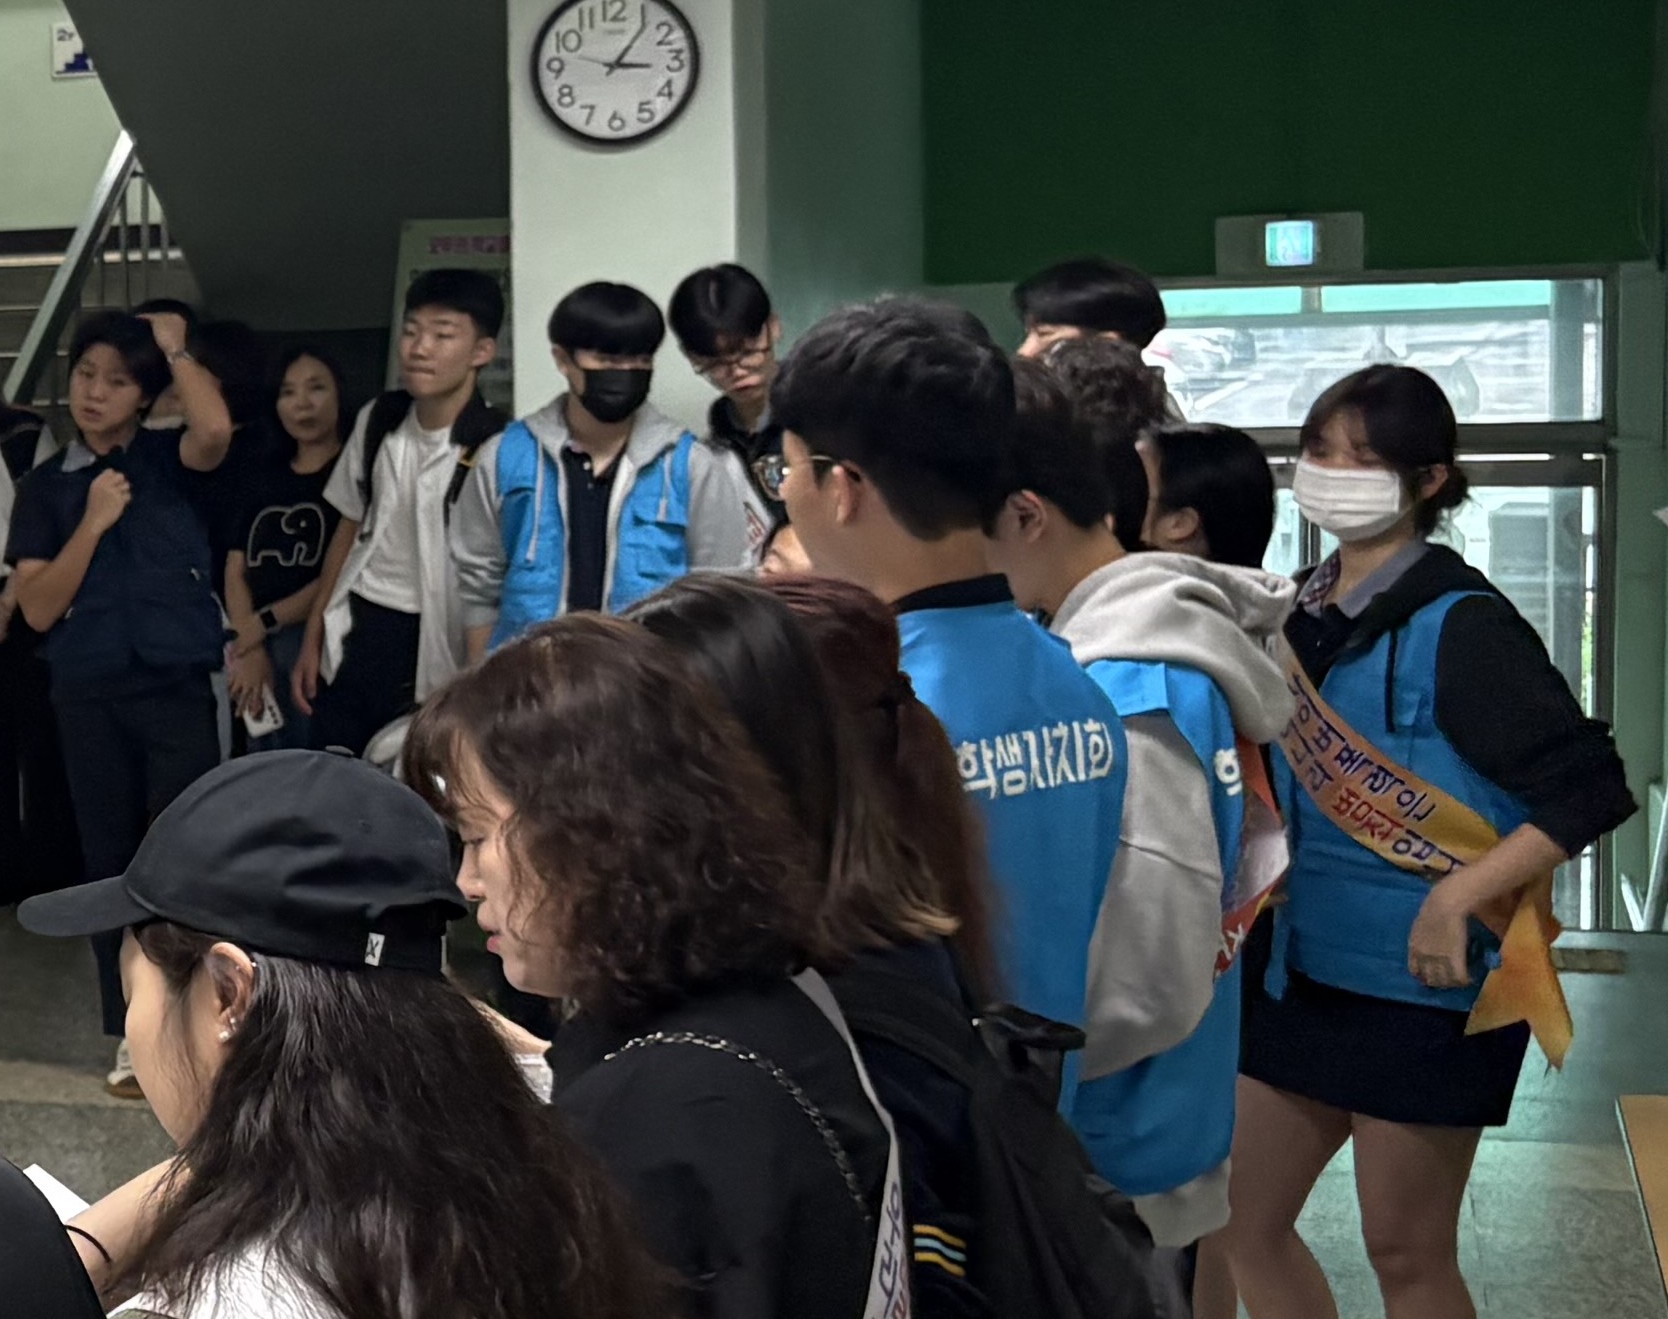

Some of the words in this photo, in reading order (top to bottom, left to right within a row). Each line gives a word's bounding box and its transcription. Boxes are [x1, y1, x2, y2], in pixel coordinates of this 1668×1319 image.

[555, 29, 582, 54] 10
[655, 21, 674, 46] 2
[546, 57, 565, 80] 9
[666, 48, 685, 73] 3
[557, 84, 576, 108] 8
[656, 79, 674, 101] 4
[579, 104, 596, 126] 7
[607, 110, 626, 132] 6
[637, 101, 656, 124] 5
[957, 718, 1114, 799] 학생자치회
